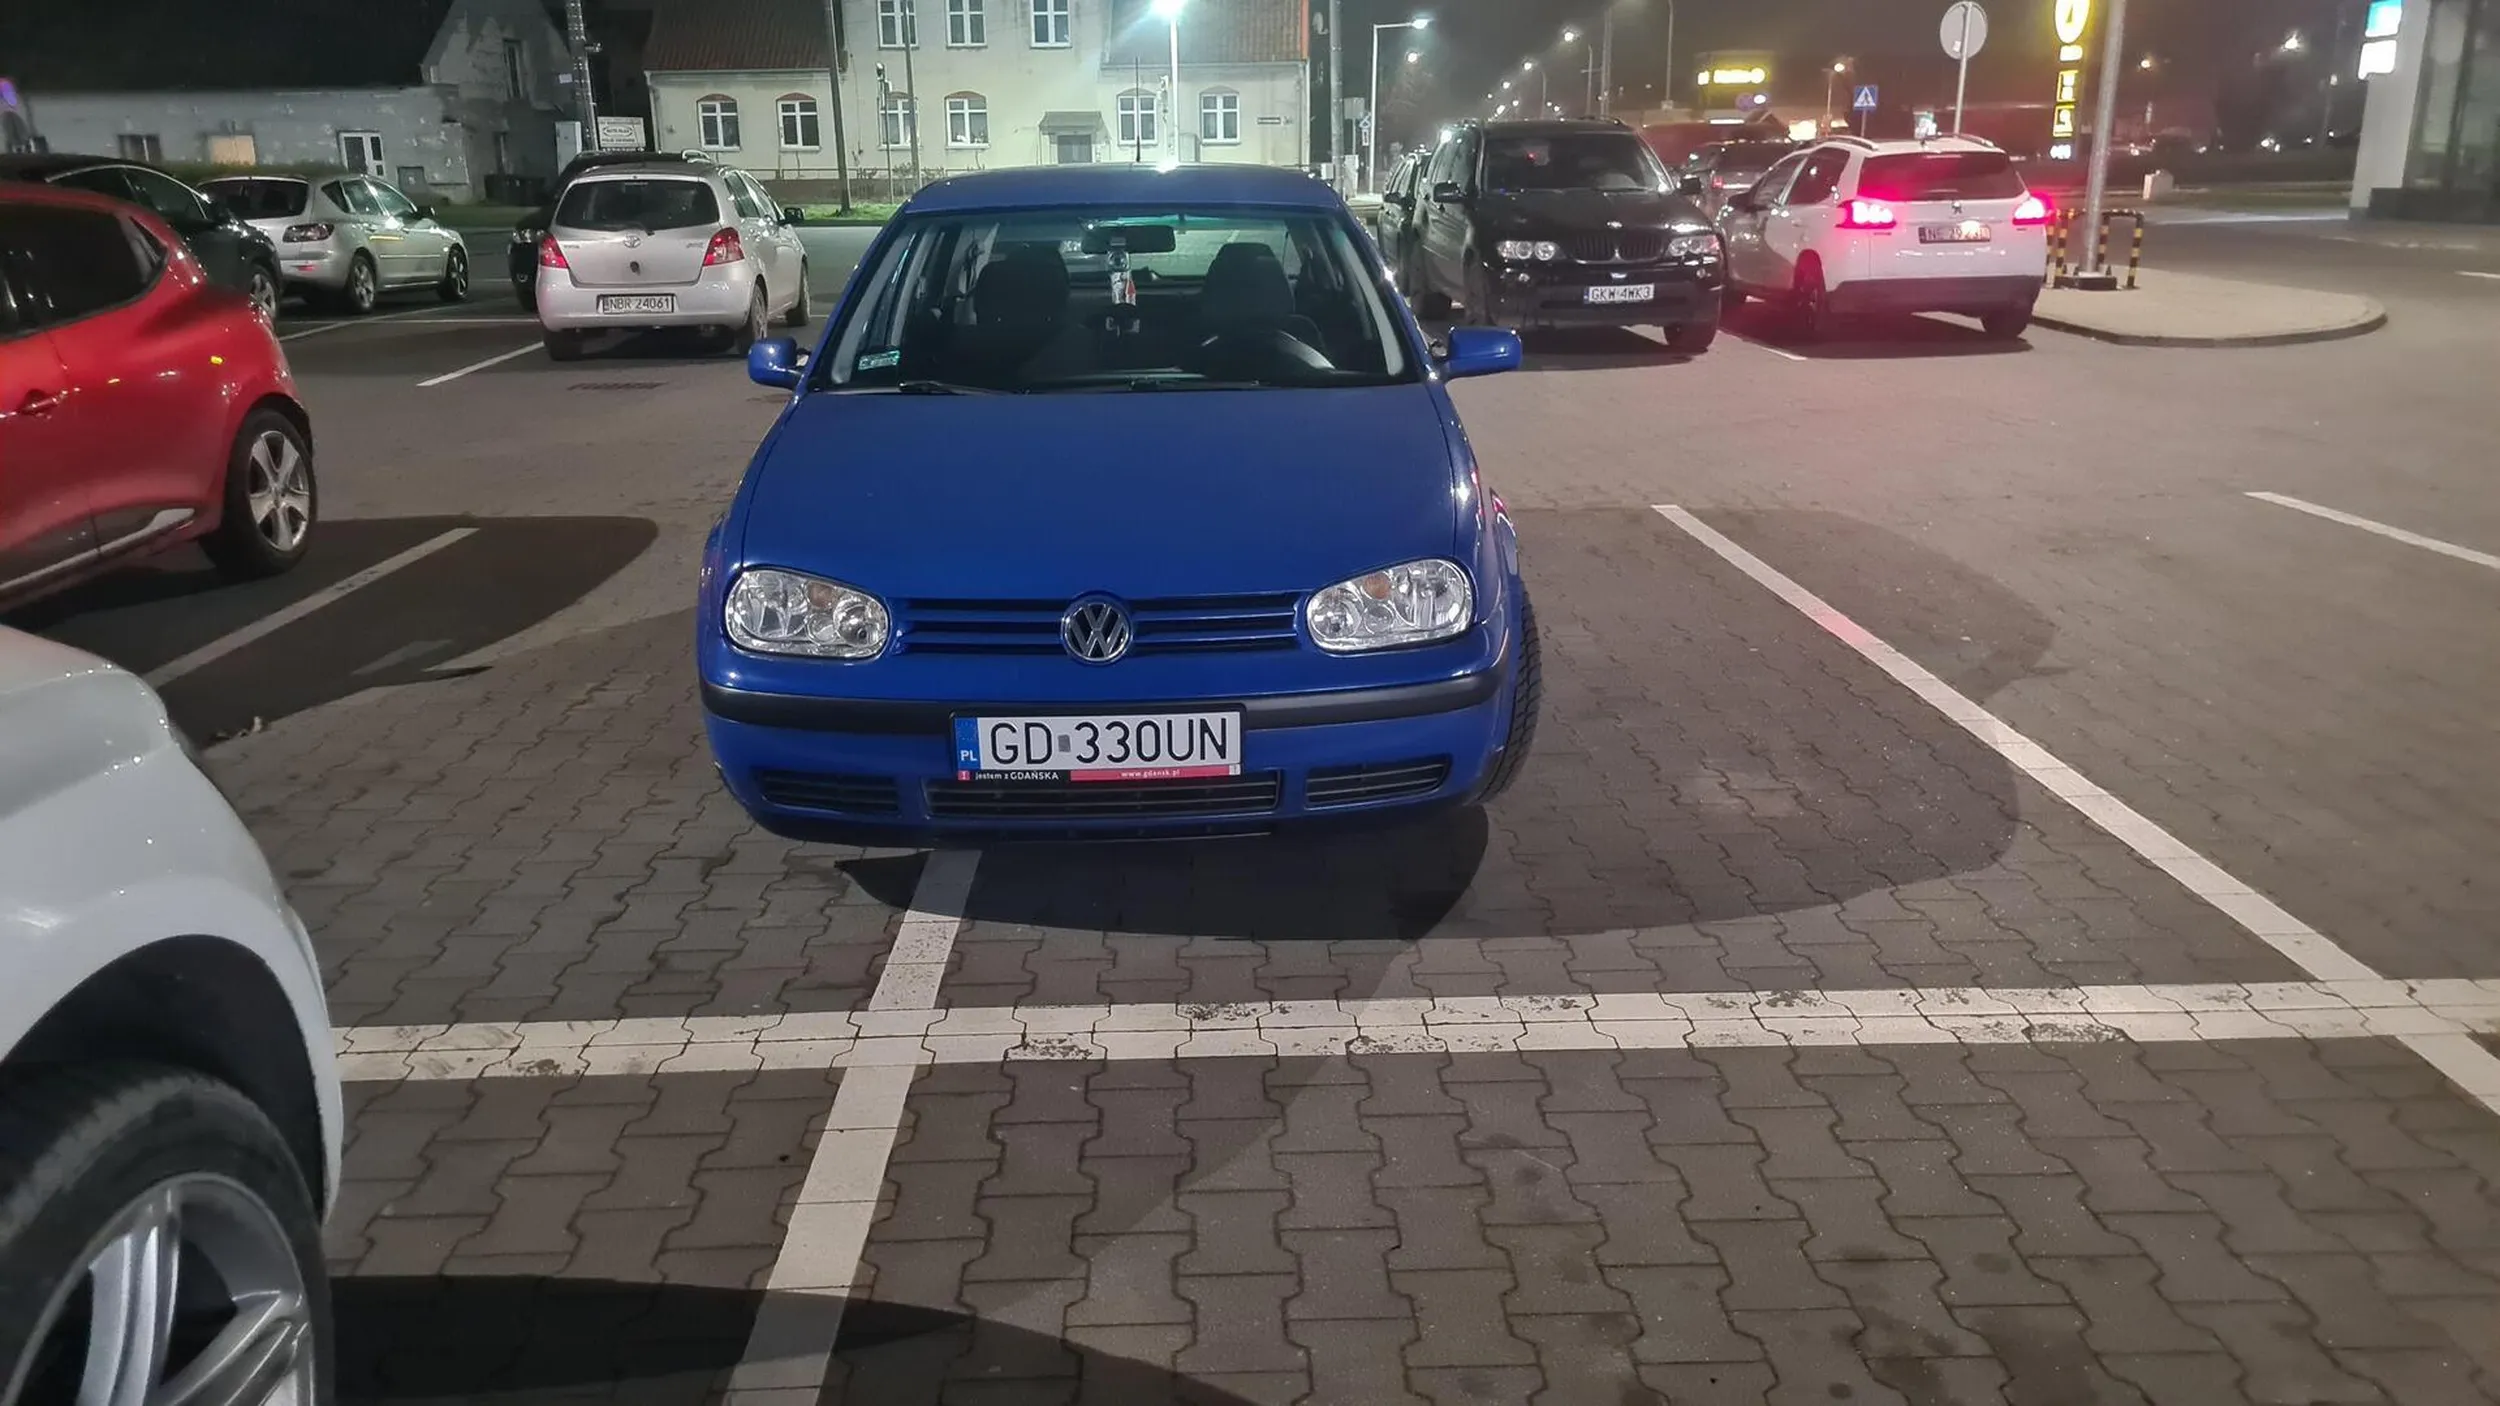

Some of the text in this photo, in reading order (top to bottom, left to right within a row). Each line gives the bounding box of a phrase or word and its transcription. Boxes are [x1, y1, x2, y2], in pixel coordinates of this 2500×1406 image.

[610, 297, 670, 310] NBR 24061
[990, 717, 1228, 765] GD 330UN
[960, 749, 978, 762] PL
